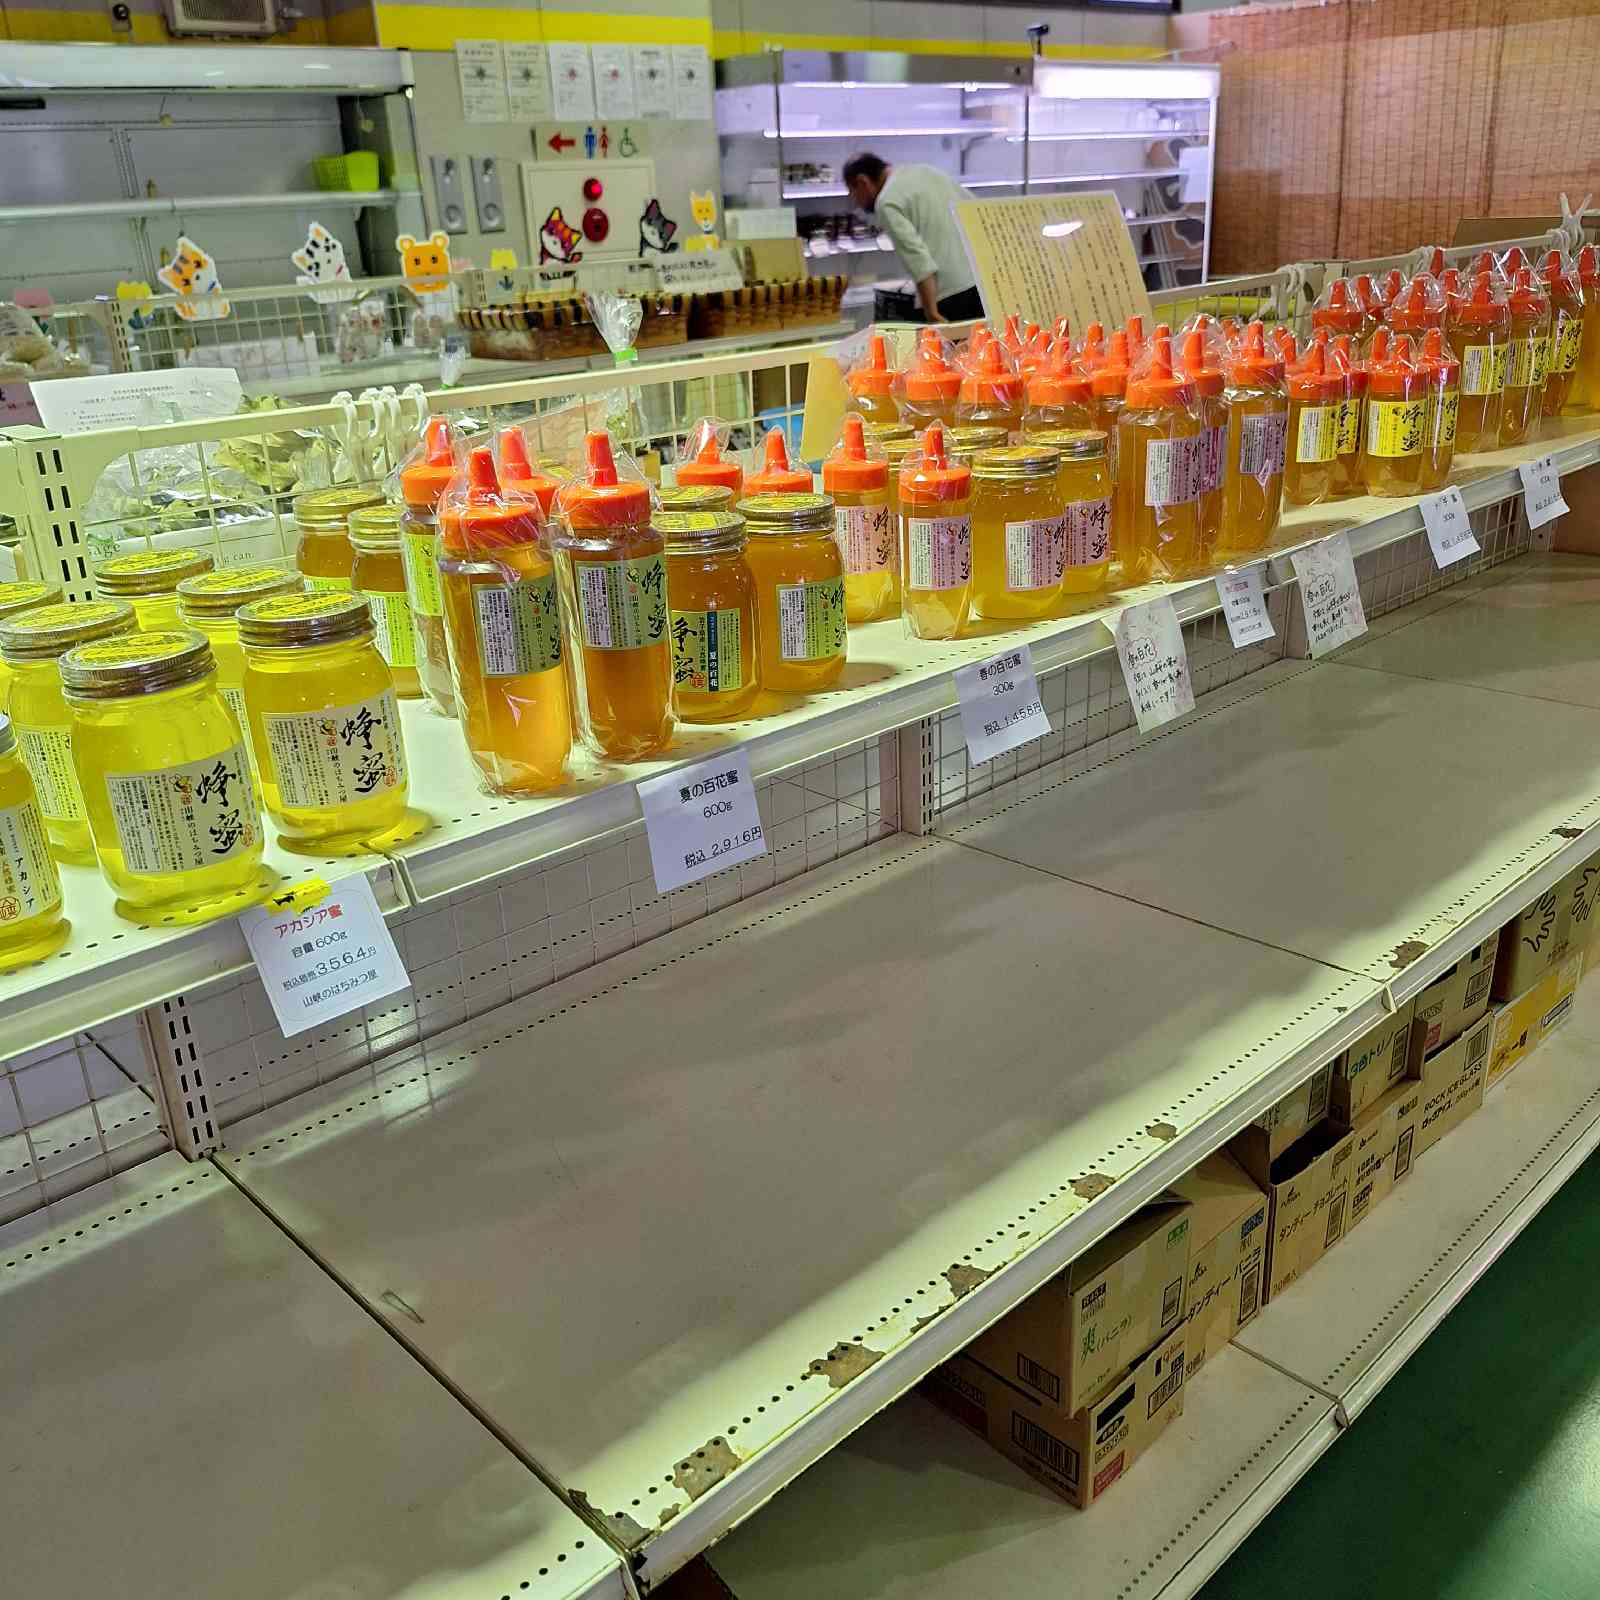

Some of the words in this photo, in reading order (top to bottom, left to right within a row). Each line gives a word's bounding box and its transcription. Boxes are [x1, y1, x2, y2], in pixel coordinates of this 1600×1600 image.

[339, 706, 386, 793] 蜂蜜
[679, 769, 739, 803] 夏の百花蜜
[196, 760, 243, 854] 蜂蜜
[703, 800, 733, 818] 600g
[685, 849, 706, 869] 税込
[711, 825, 762, 857] 2,916円
[15, 857, 35, 908] アカシア
[274, 904, 343, 938] アカシア蜜
[302, 969, 379, 1008] 山峡のはちみつ屋
[1424, 1089, 1446, 1113] ROCK
